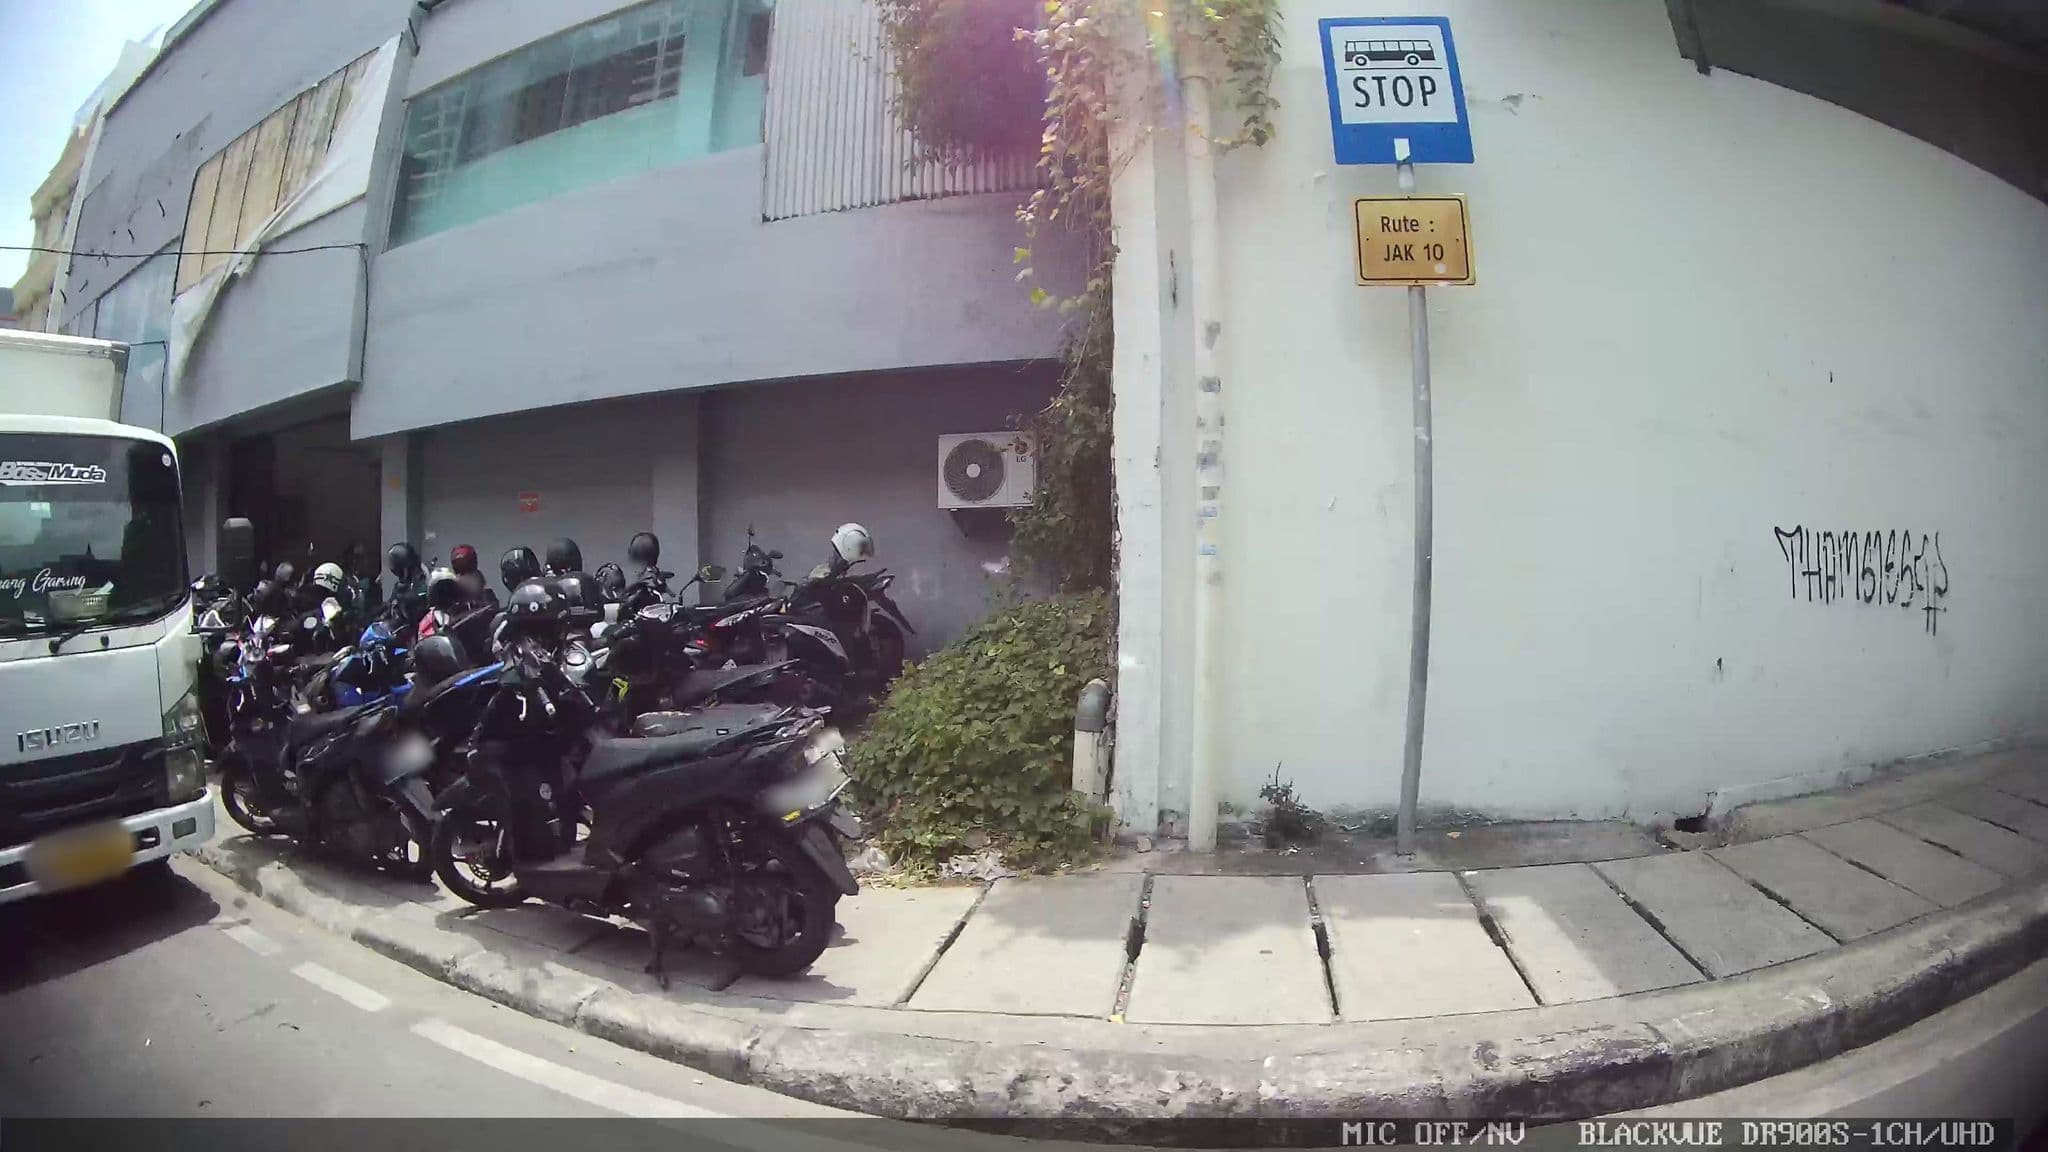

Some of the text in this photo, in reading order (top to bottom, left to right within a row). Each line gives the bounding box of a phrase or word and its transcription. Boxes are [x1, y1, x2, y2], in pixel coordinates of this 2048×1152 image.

[1352, 75, 1437, 108] STOP
[1380, 215, 1420, 233] Rute
[1383, 243, 1445, 262] JAK 10
[48, 463, 106, 482] Muda
[17, 719, 99, 753] ISUZU
